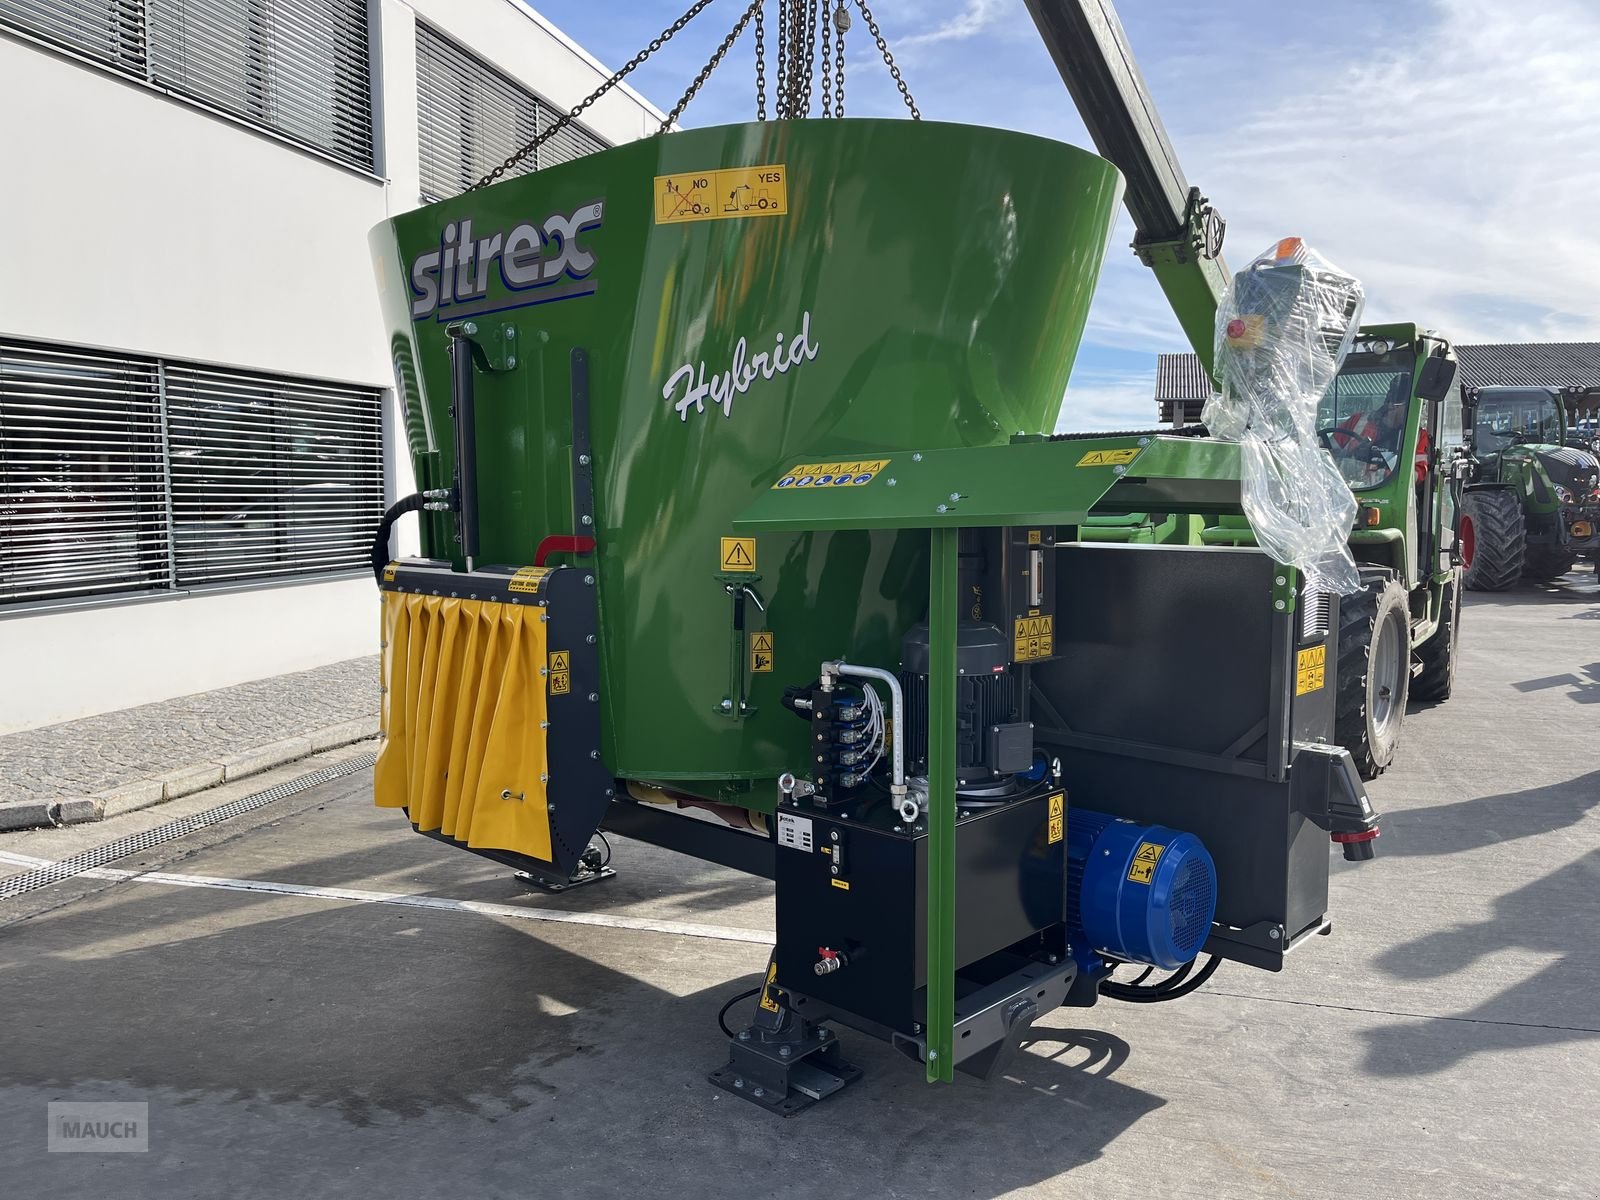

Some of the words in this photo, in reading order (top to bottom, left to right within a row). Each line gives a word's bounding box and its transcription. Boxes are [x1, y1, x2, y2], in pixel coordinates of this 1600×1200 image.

[693, 178, 708, 189] NO
[758, 172, 781, 184] YES
[662, 311, 820, 423] Hybrid
